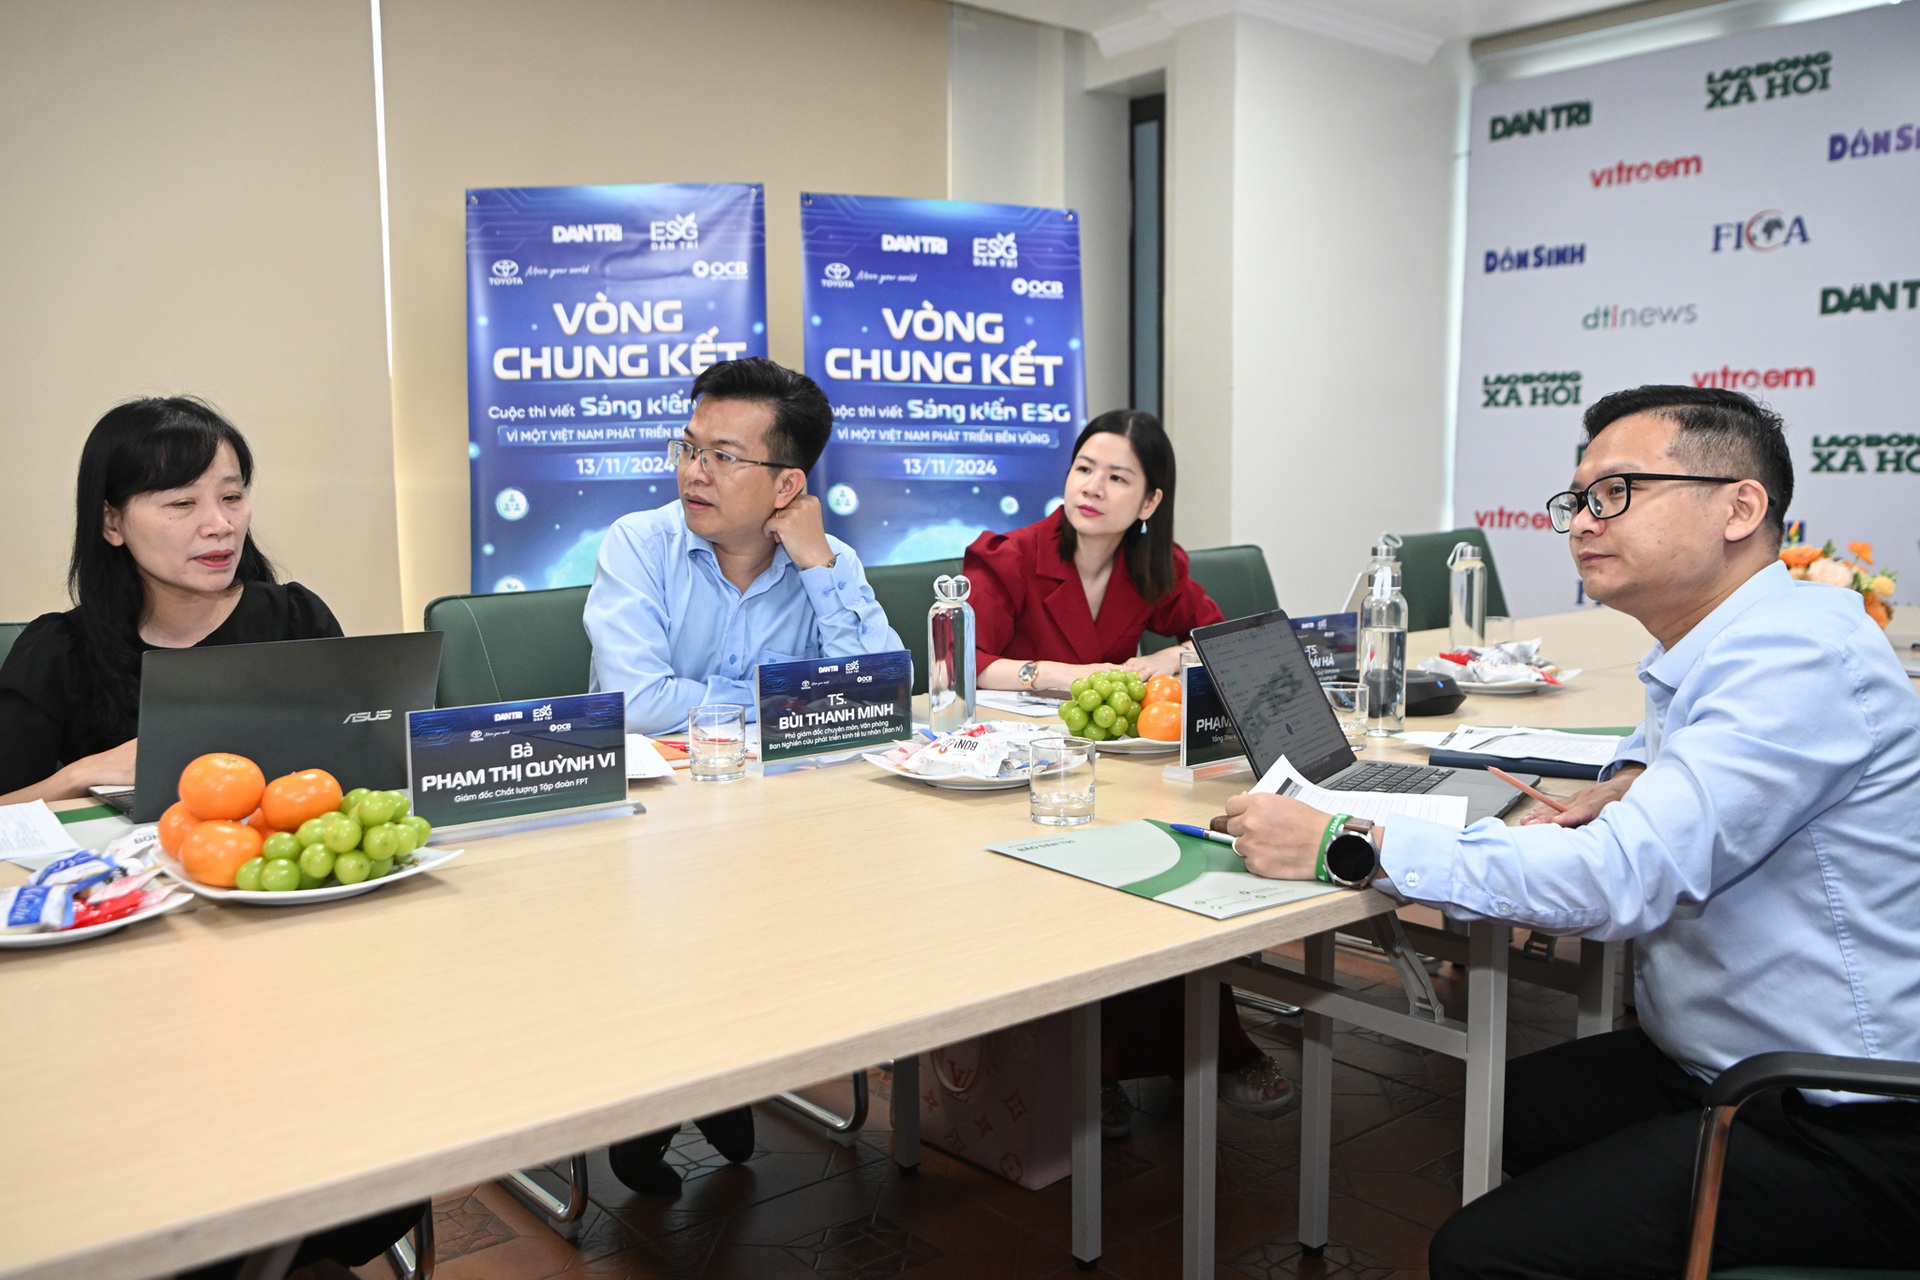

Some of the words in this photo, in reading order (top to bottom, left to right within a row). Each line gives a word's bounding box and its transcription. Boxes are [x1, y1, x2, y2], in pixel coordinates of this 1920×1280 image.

[650, 219, 698, 241] ESG
[1712, 209, 1811, 253] FICA
[973, 236, 1018, 258] ESG
[711, 261, 748, 275] OCB
[489, 277, 523, 286] TOYOTA
[821, 279, 855, 288] TOYOTA
[1028, 279, 1064, 293] OCB
[553, 291, 683, 335] VÒNG
[881, 300, 1004, 343] VÒNG
[493, 345, 649, 380] CHUNG
[824, 347, 972, 383] CHUNG
[981, 339, 1063, 386] KẾT
[488, 405, 525, 421] Cuộc
[528, 405, 547, 418] thi
[549, 403, 575, 418] viết
[580, 394, 641, 419] Sáng
[830, 404, 856, 420] uộc
[858, 406, 876, 418] thi
[877, 404, 903, 419] viết
[907, 397, 966, 423] Sáng
[970, 396, 1017, 421] kiến
[1022, 402, 1071, 422] ESG
[506, 428, 518, 442] VÌ
[521, 428, 548, 443] MỘT
[550, 427, 575, 443] VIỆT
[577, 429, 604, 440] NAM
[606, 426, 636, 440] PHÁT
[851, 427, 877, 443] MỘT
[879, 427, 902, 443] VIỆT
[904, 430, 930, 441] NAM
[932, 428, 961, 442] PHÁT
[576, 457, 676, 476] 13/11/2024
[903, 458, 997, 476] 13/11/2024
[827, 693, 847, 706] TS.
[343, 710, 392, 724] ASUS
[779, 712, 803, 730] BÙI
[805, 708, 855, 726] THANH
[858, 703, 894, 720] MINH
[842, 732, 854, 740] kinh
[511, 742, 533, 759] Bà
[422, 769, 486, 792] PHẠM
[488, 765, 522, 782] THỊ
[525, 754, 594, 778] QUỲNH
[597, 752, 616, 768] VI
[454, 791, 476, 803] Giám
[478, 789, 494, 800] đốc
[495, 786, 514, 797] Chất
[515, 784, 538, 796] lượng
[539, 782, 553, 792] Tập
[555, 779, 574, 789] đoàn
[576, 777, 590, 787] FPT
